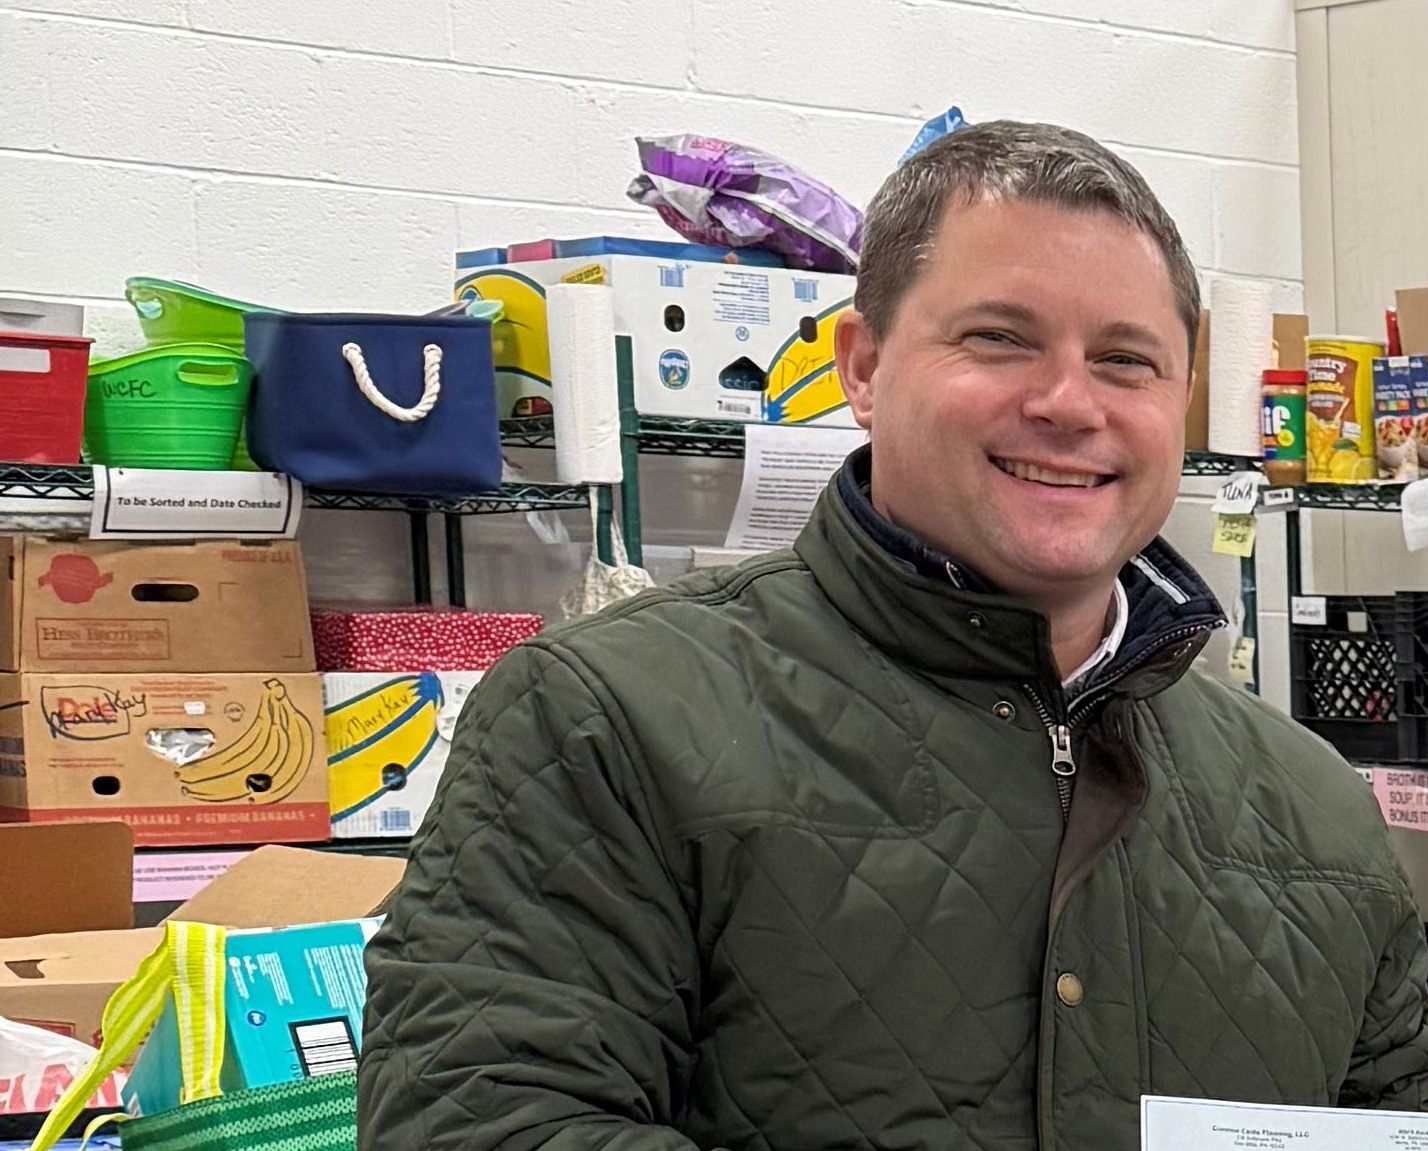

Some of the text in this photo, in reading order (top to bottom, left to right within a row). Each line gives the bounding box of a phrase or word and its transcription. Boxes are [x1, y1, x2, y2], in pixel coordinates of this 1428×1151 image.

[1264, 406, 1291, 435] if
[118, 497, 281, 509] To be Sorted and Date Checked
[249, 811, 304, 822] BANANAS
